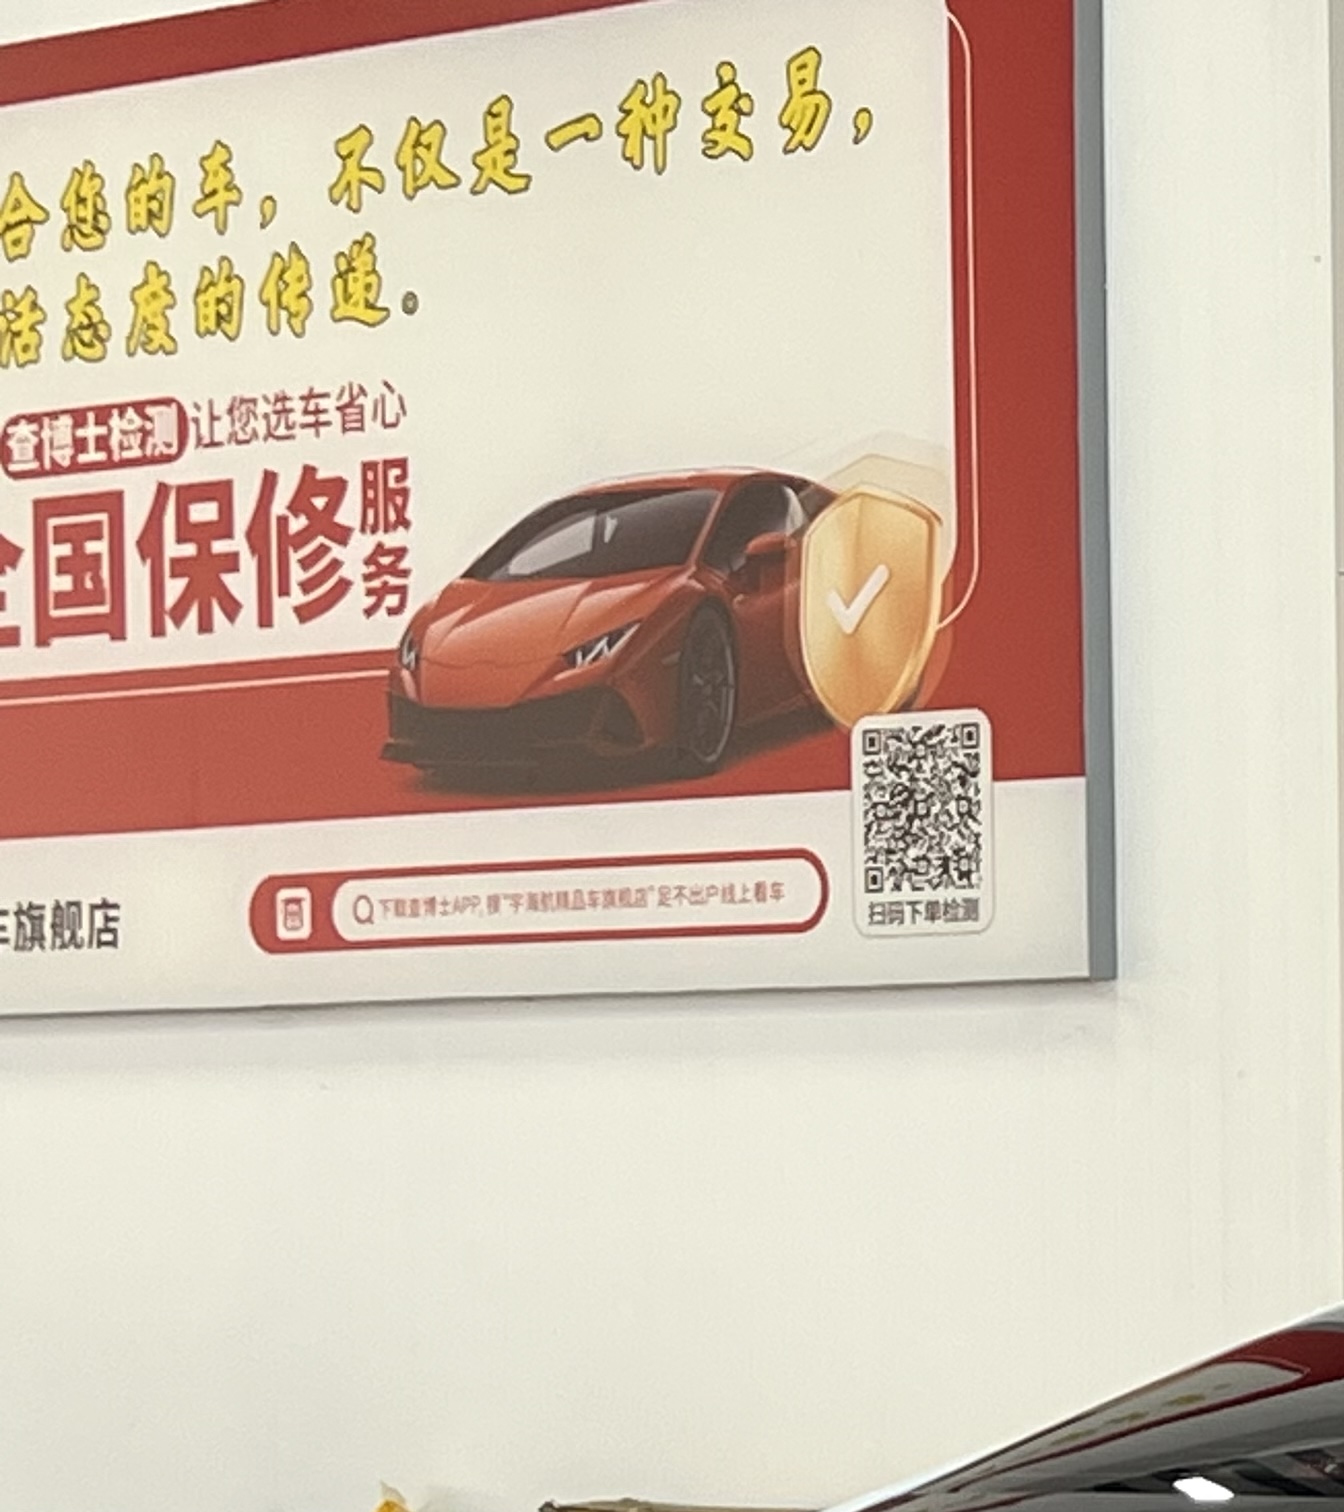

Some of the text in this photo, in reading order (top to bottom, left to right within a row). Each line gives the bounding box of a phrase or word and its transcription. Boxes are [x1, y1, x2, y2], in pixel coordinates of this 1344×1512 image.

[6, 380, 408, 471] 查博士检测 让您选车省心
[0, 456, 412, 649] 国保修 服务
[0, 897, 121, 952] 旗舰店
